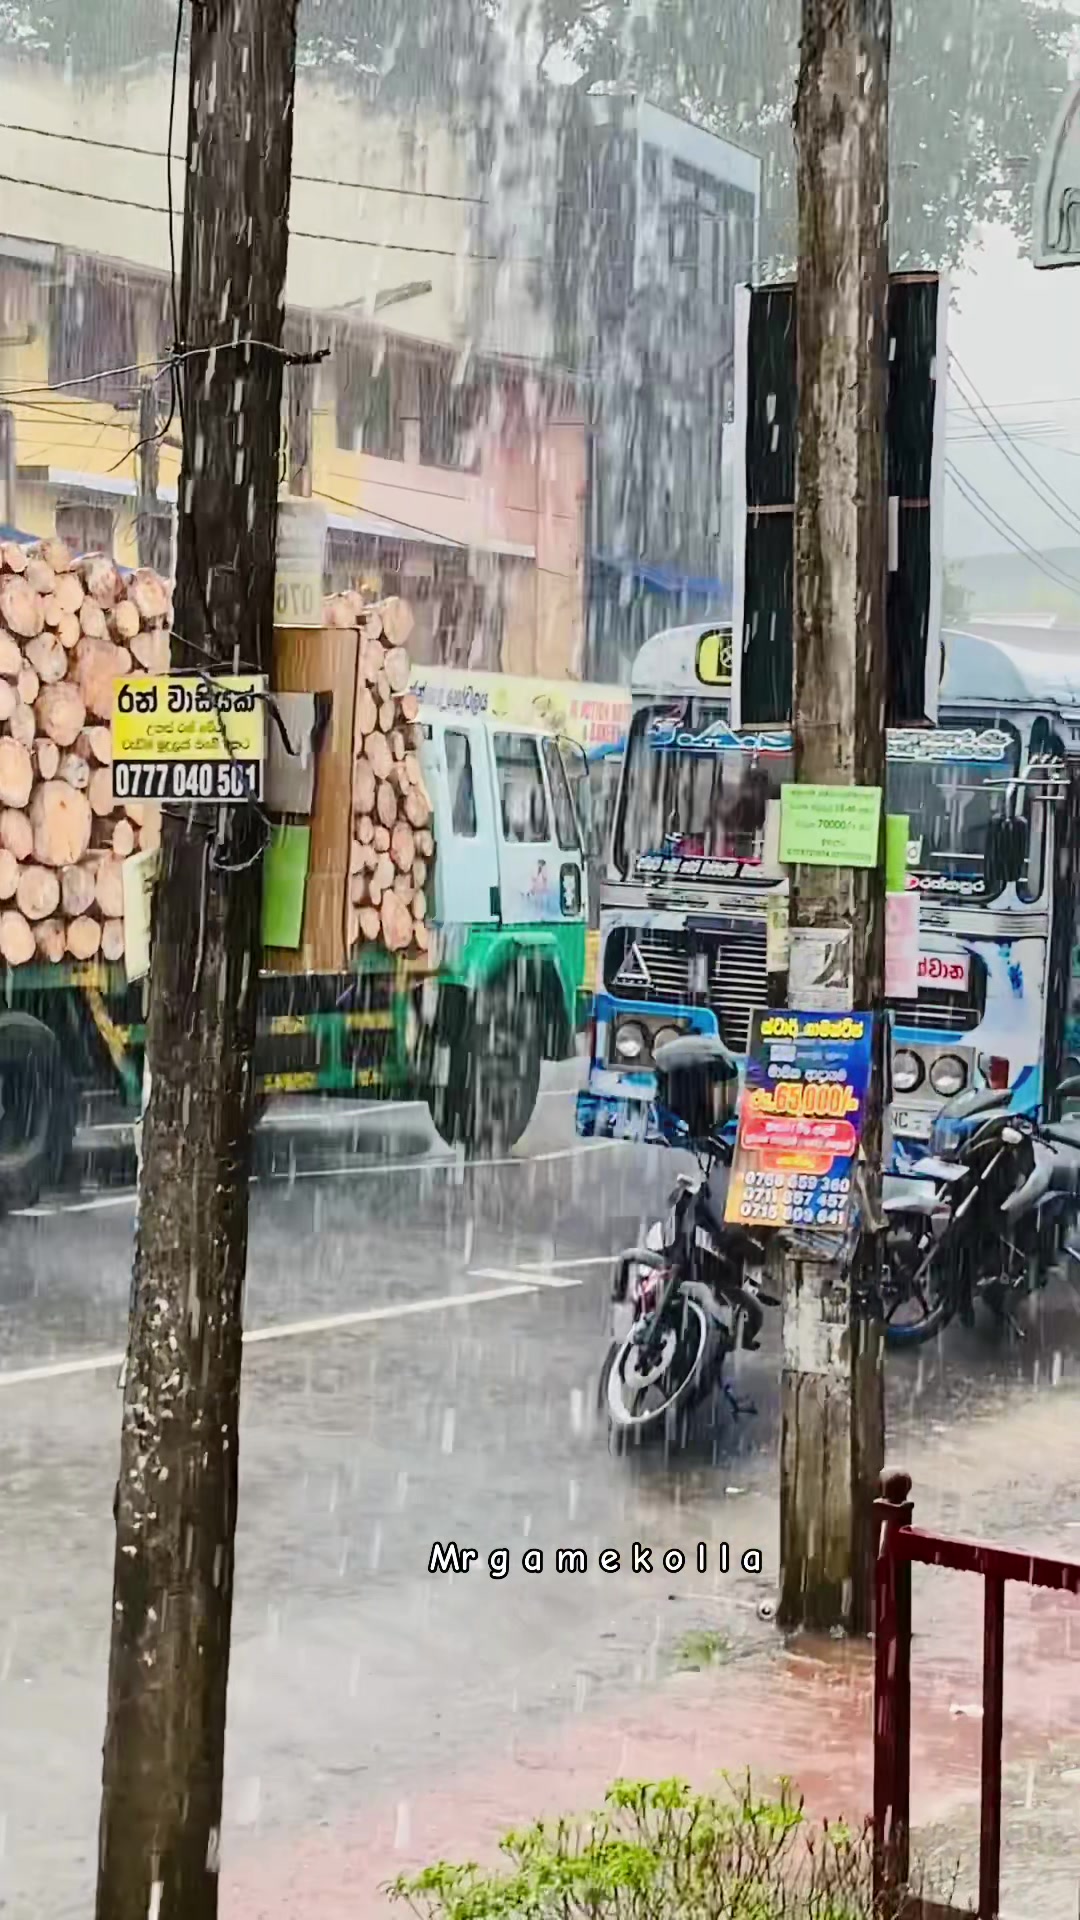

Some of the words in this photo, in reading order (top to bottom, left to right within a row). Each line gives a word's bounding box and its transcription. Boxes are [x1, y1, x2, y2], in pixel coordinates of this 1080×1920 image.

[118, 684, 158, 713] රන්
[115, 763, 168, 796] 0777
[173, 763, 212, 796] 040
